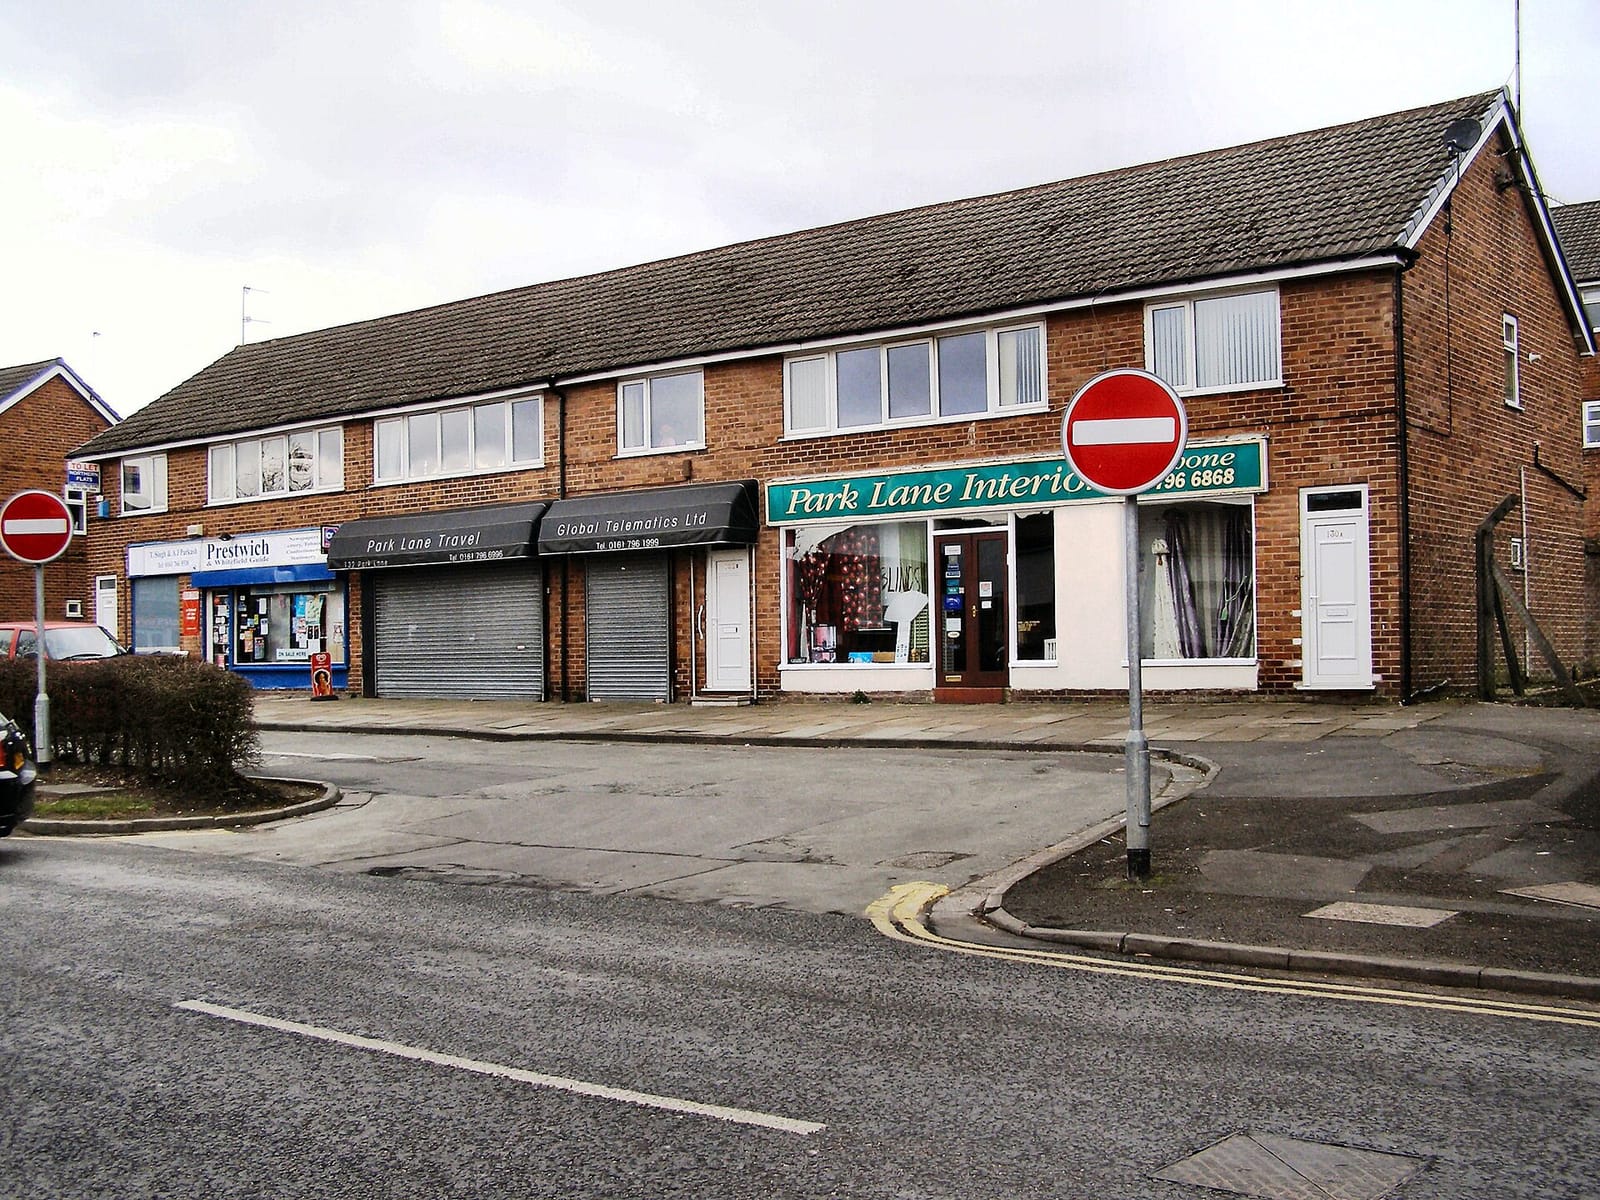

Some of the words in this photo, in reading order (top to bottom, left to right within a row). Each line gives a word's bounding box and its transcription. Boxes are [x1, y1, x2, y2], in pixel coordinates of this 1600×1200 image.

[84, 463, 98, 471] LET
[1190, 467, 1236, 487] 6868
[785, 482, 859, 514] Park
[867, 481, 952, 508] Lane
[959, 465, 1092, 501] Interio
[557, 521, 599, 536] Global
[606, 515, 678, 532] Telematics
[685, 511, 707, 526] Ltd
[207, 538, 269, 560] Prestwich
[367, 539, 395, 553] Park
[400, 536, 432, 551] Lane
[439, 531, 481, 548] Travel
[608, 541, 625, 550] 0161
[627, 540, 641, 548] 796
[642, 538, 660, 547] 1999
[214, 558, 248, 566] Whitefield
[459, 552, 474, 560] 0161
